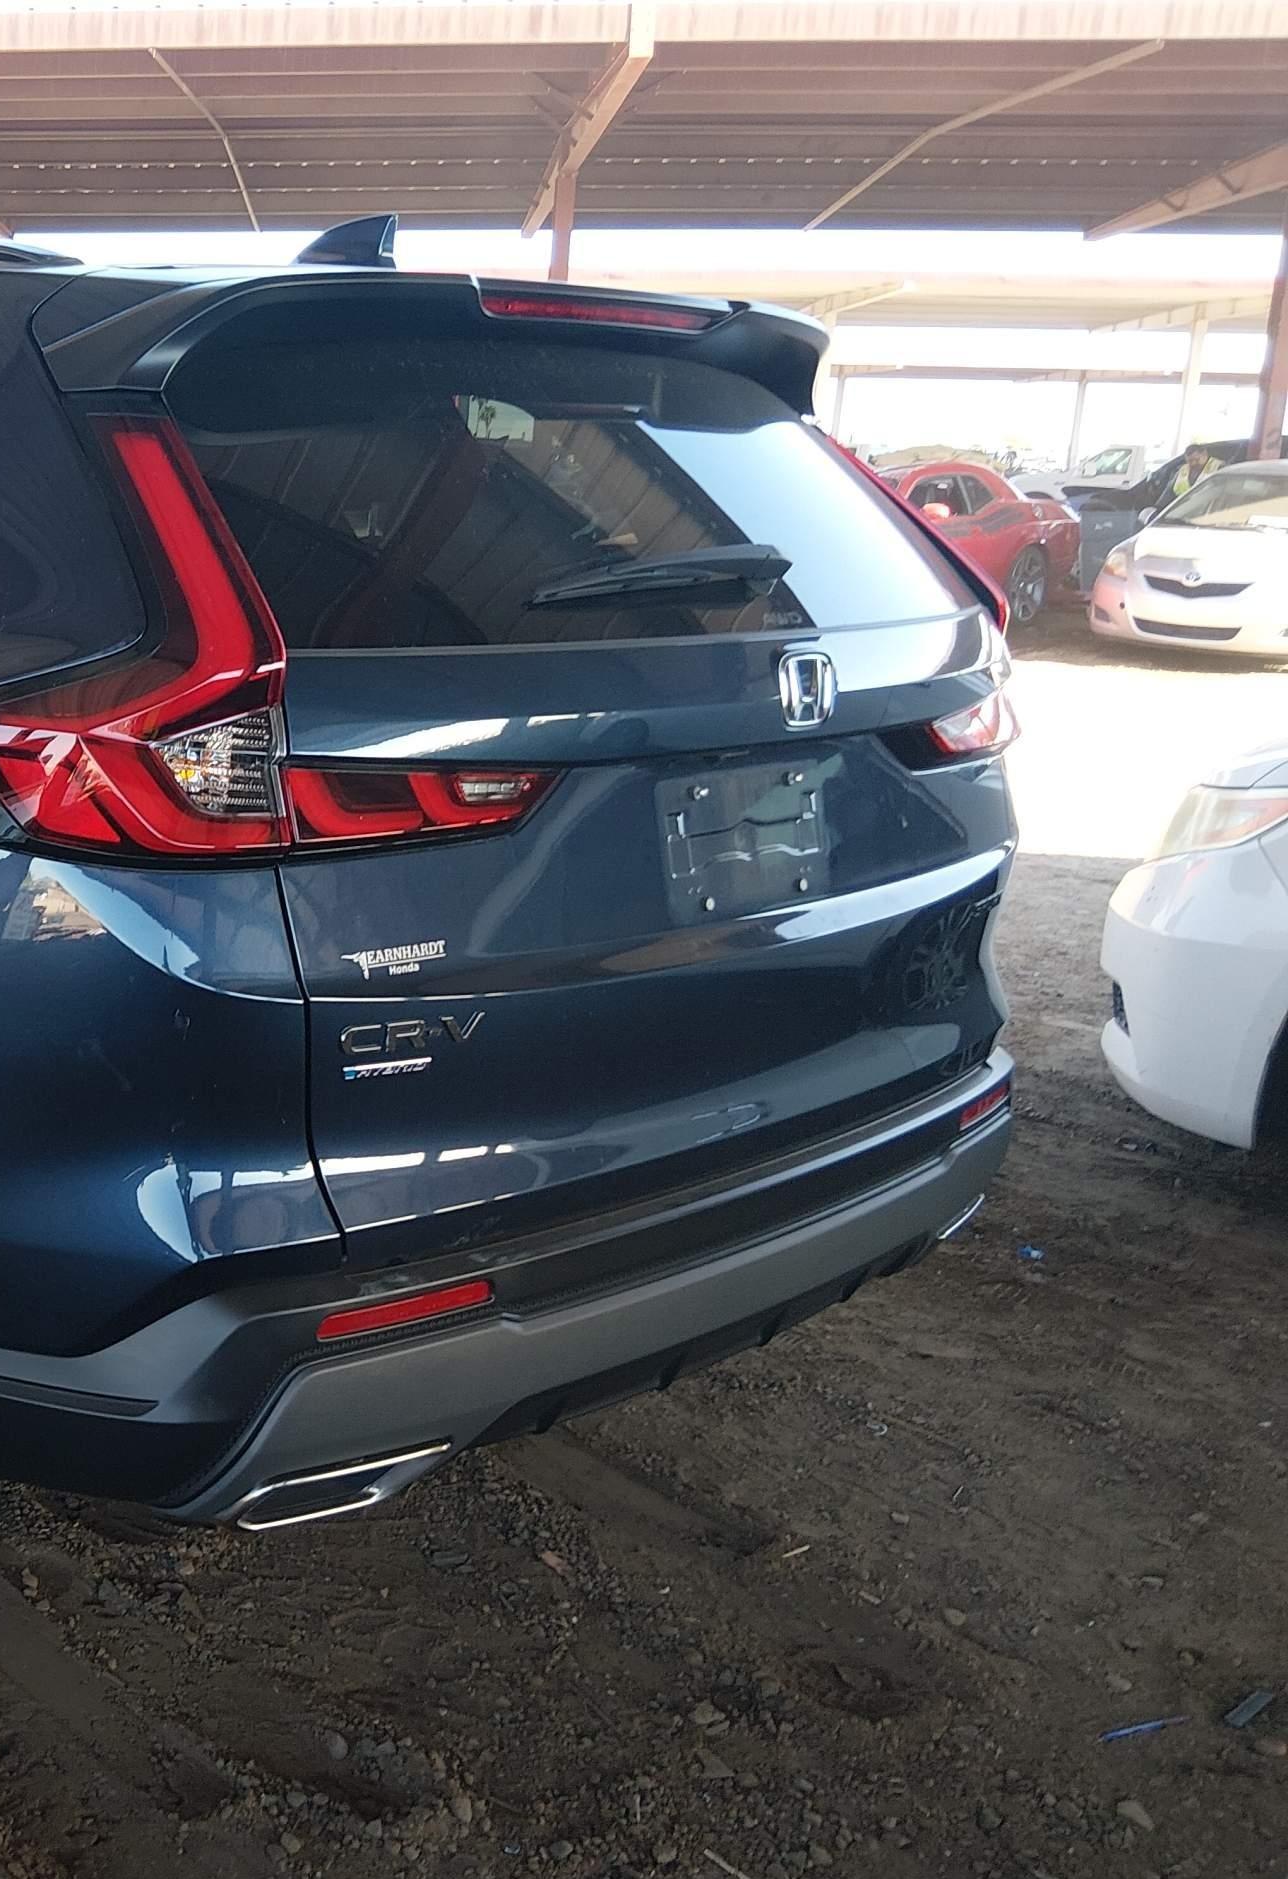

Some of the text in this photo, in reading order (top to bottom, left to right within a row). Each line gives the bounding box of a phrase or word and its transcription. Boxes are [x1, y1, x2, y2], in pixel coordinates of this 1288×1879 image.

[367, 939, 446, 964] EARNHARDT
[388, 962, 420, 976] Honda
[340, 1011, 486, 1055] CR-V
